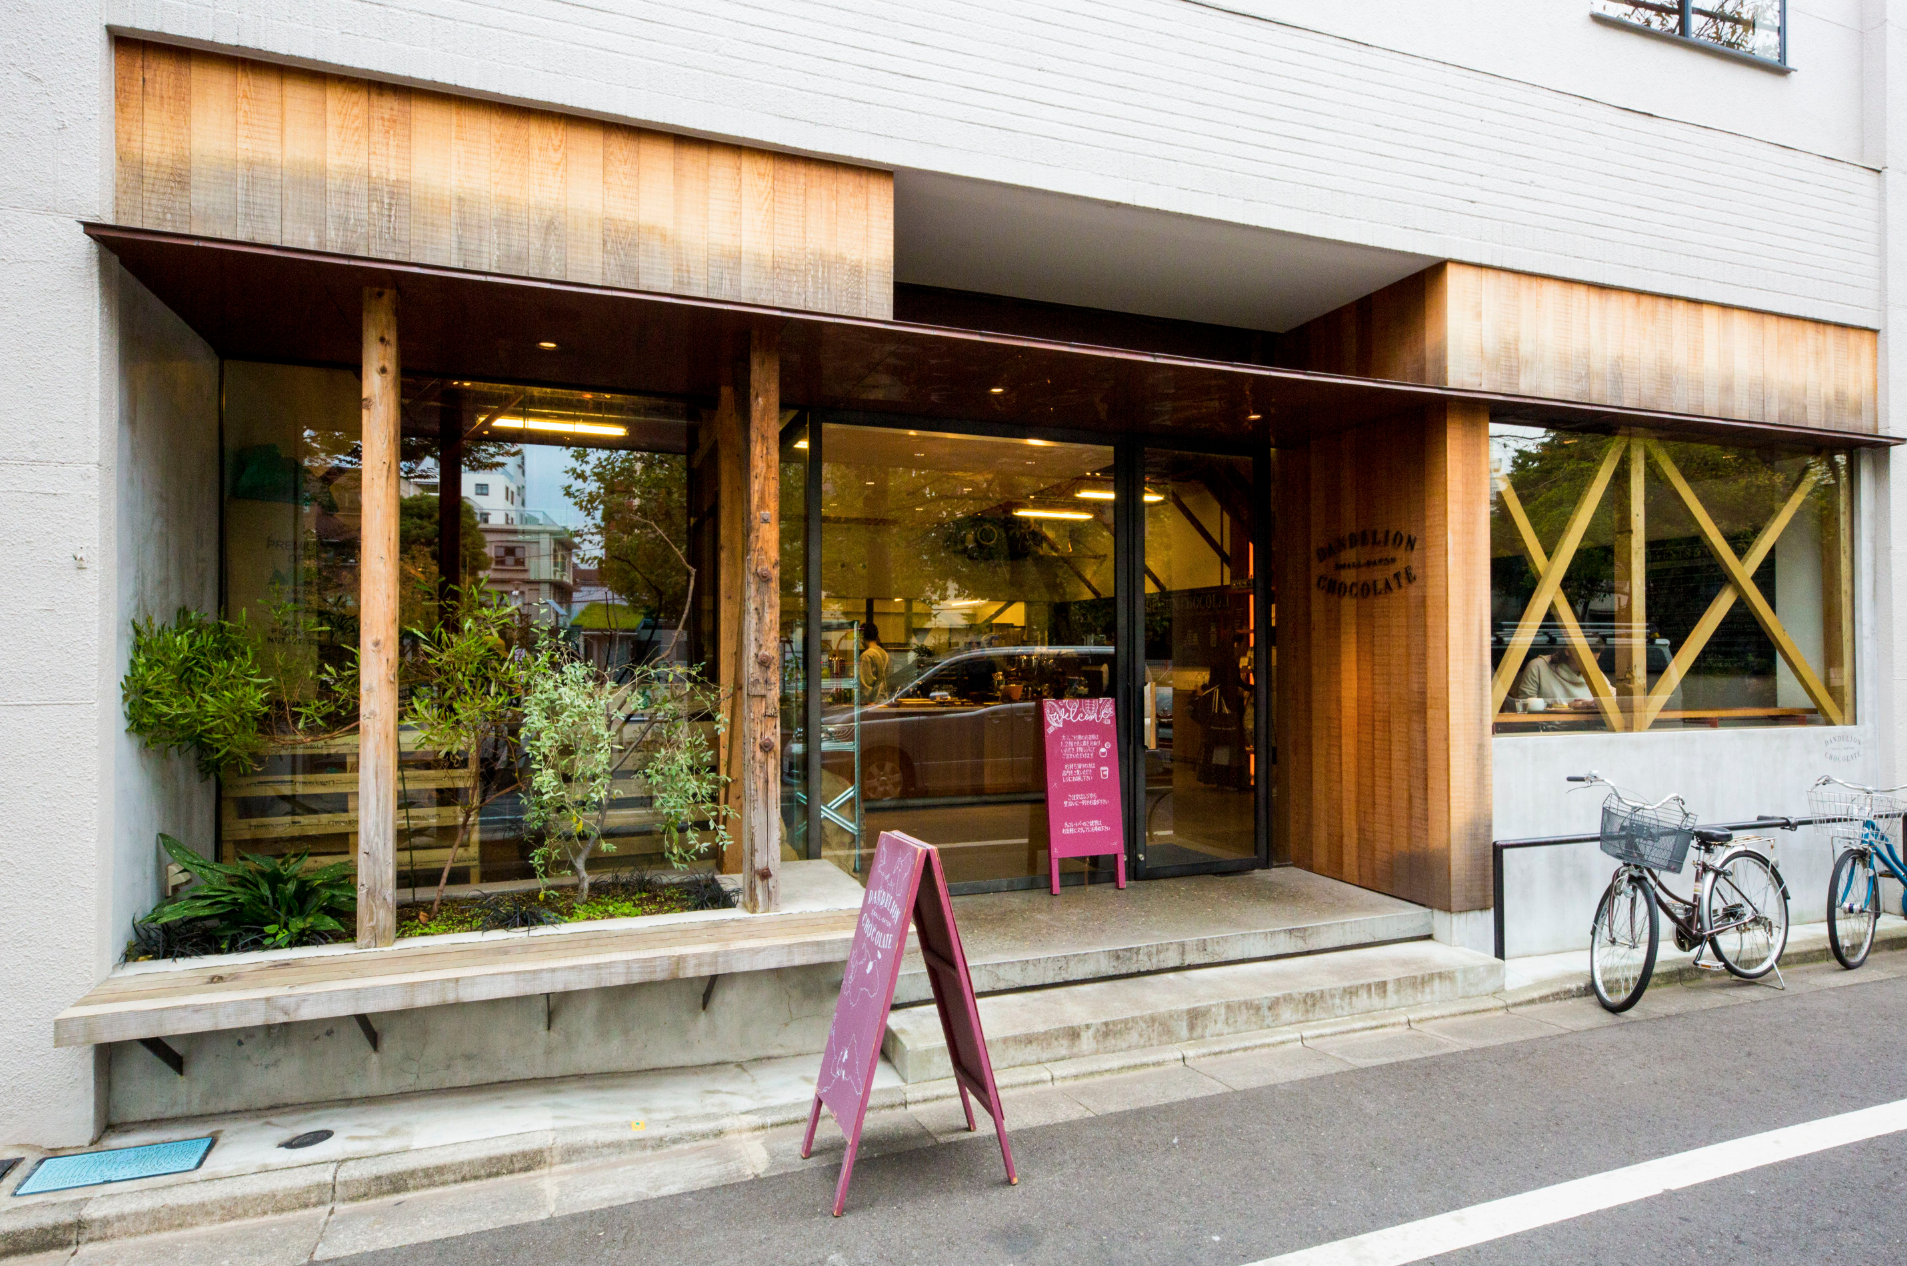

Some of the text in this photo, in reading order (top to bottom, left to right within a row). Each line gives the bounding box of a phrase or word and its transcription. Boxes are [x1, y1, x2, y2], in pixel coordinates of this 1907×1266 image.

[1316, 529, 1417, 563] DANDELION
[1316, 565, 1417, 599] CHOCOLATE
[1824, 750, 1861, 763] CHOCOLATE
[867, 889, 901, 925] DANDELION
[861, 913, 893, 949] CHOCOLATE
